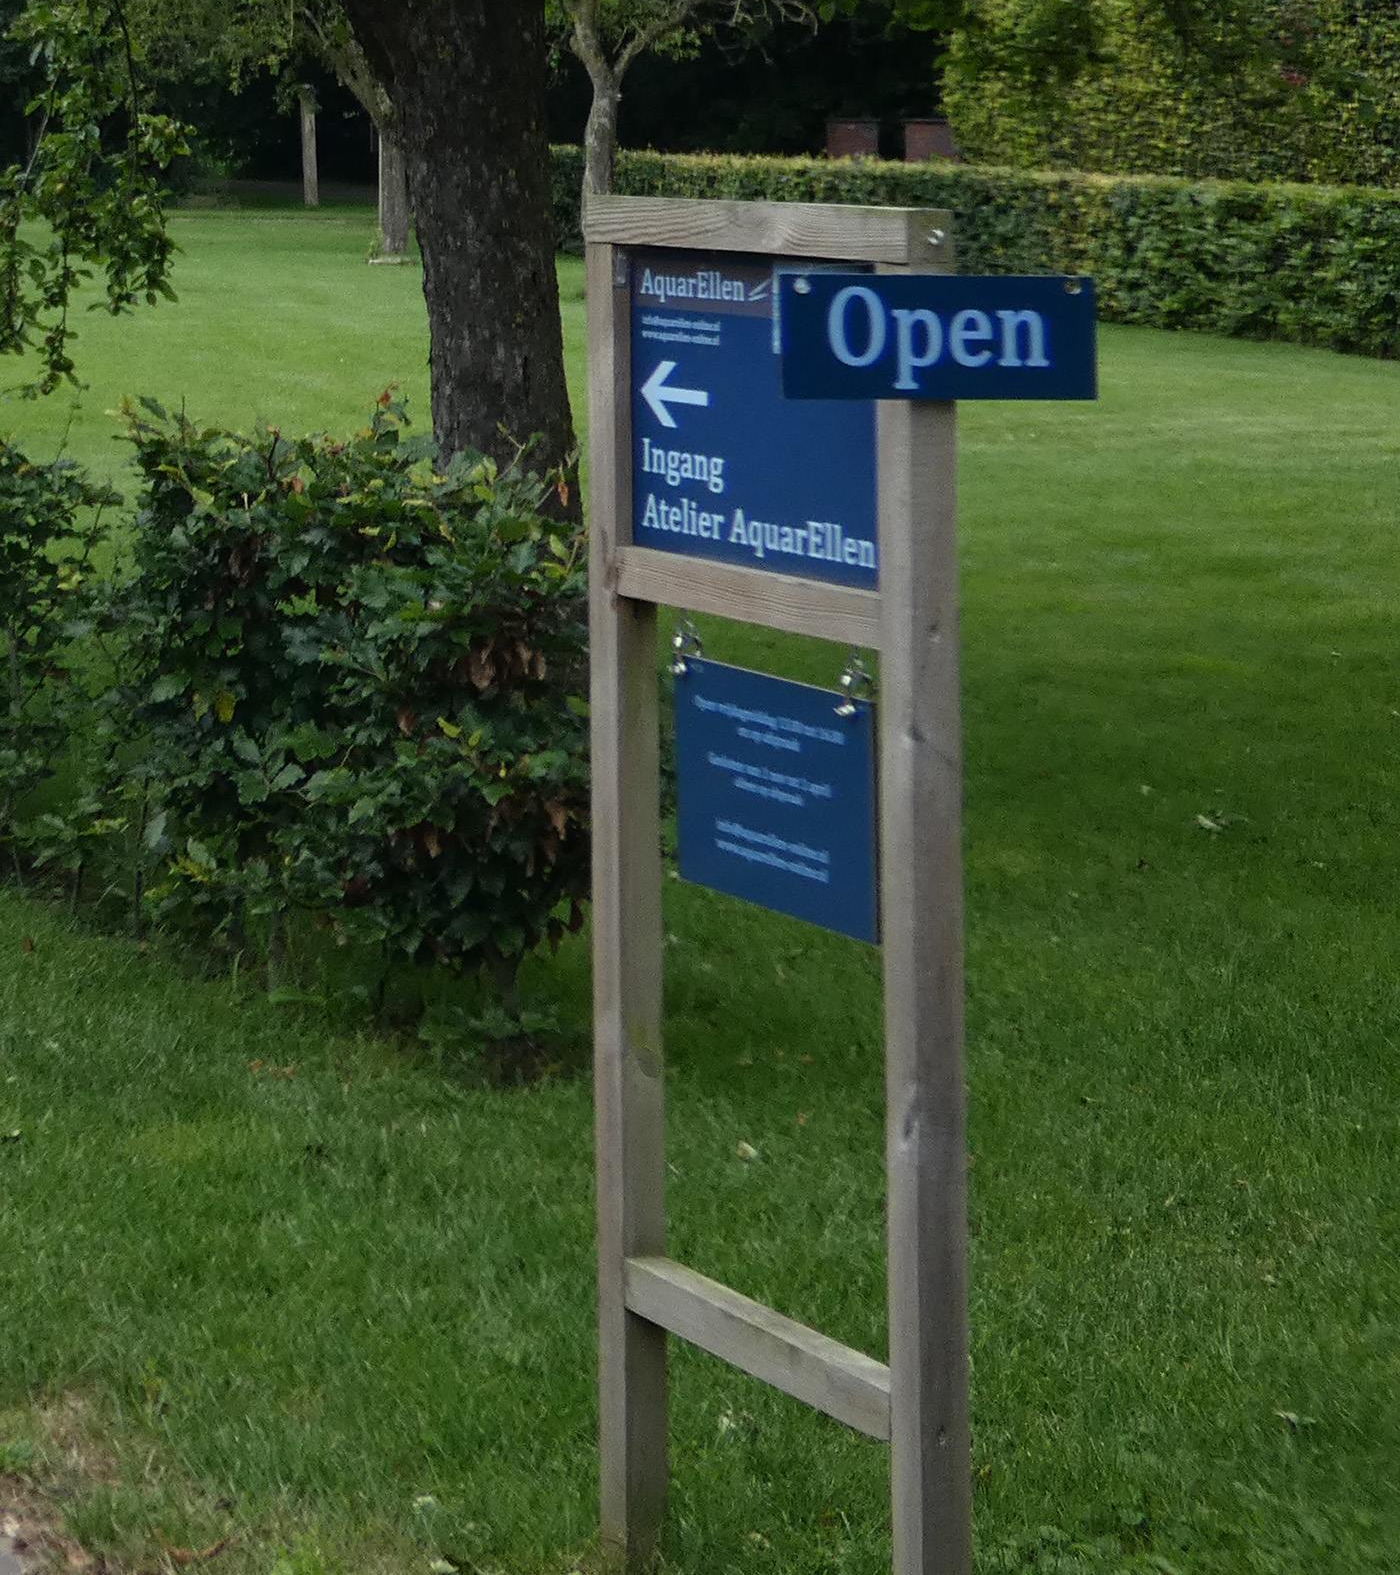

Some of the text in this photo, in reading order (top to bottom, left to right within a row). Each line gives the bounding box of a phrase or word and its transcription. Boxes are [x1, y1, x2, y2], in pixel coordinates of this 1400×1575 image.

[640, 267, 745, 303] AquarEllen
[827, 285, 1050, 390] Open
[641, 437, 725, 494] Ingang
[641, 493, 877, 570] Atelier AquarEllen
